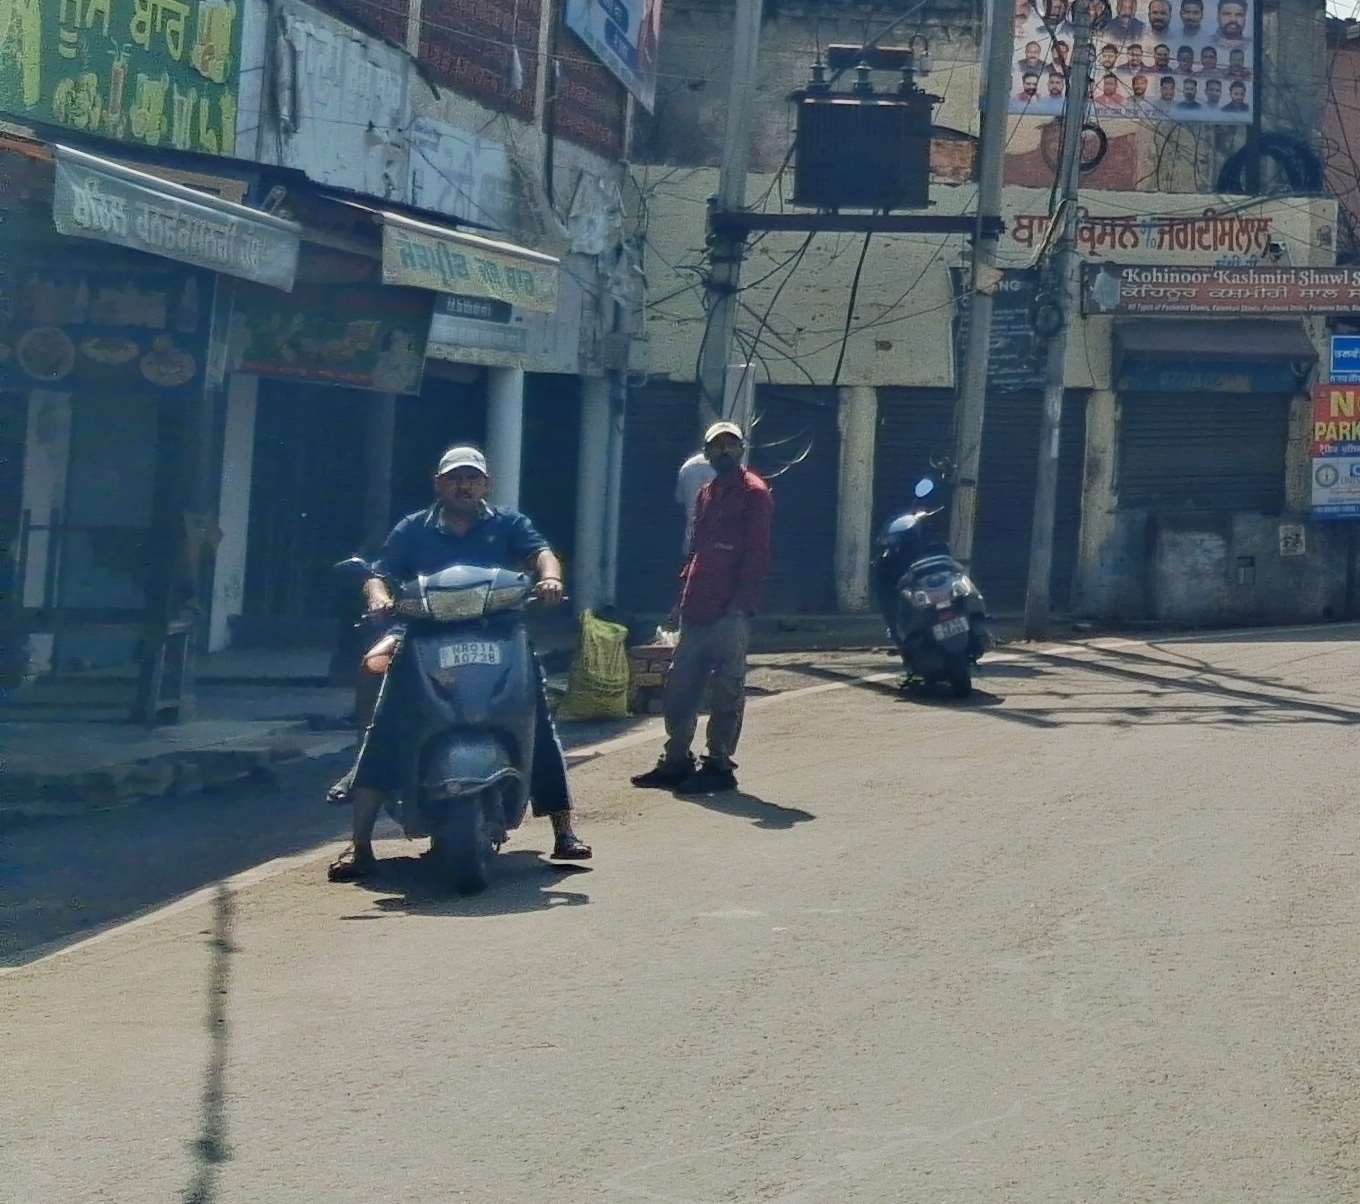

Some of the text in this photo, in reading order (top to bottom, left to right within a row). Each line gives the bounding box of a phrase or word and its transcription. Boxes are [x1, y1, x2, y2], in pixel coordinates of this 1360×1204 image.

[1122, 268, 1211, 284] Kohinoor
[1213, 269, 1296, 284] Kashmiri
[1299, 270, 1349, 285] Shawl
